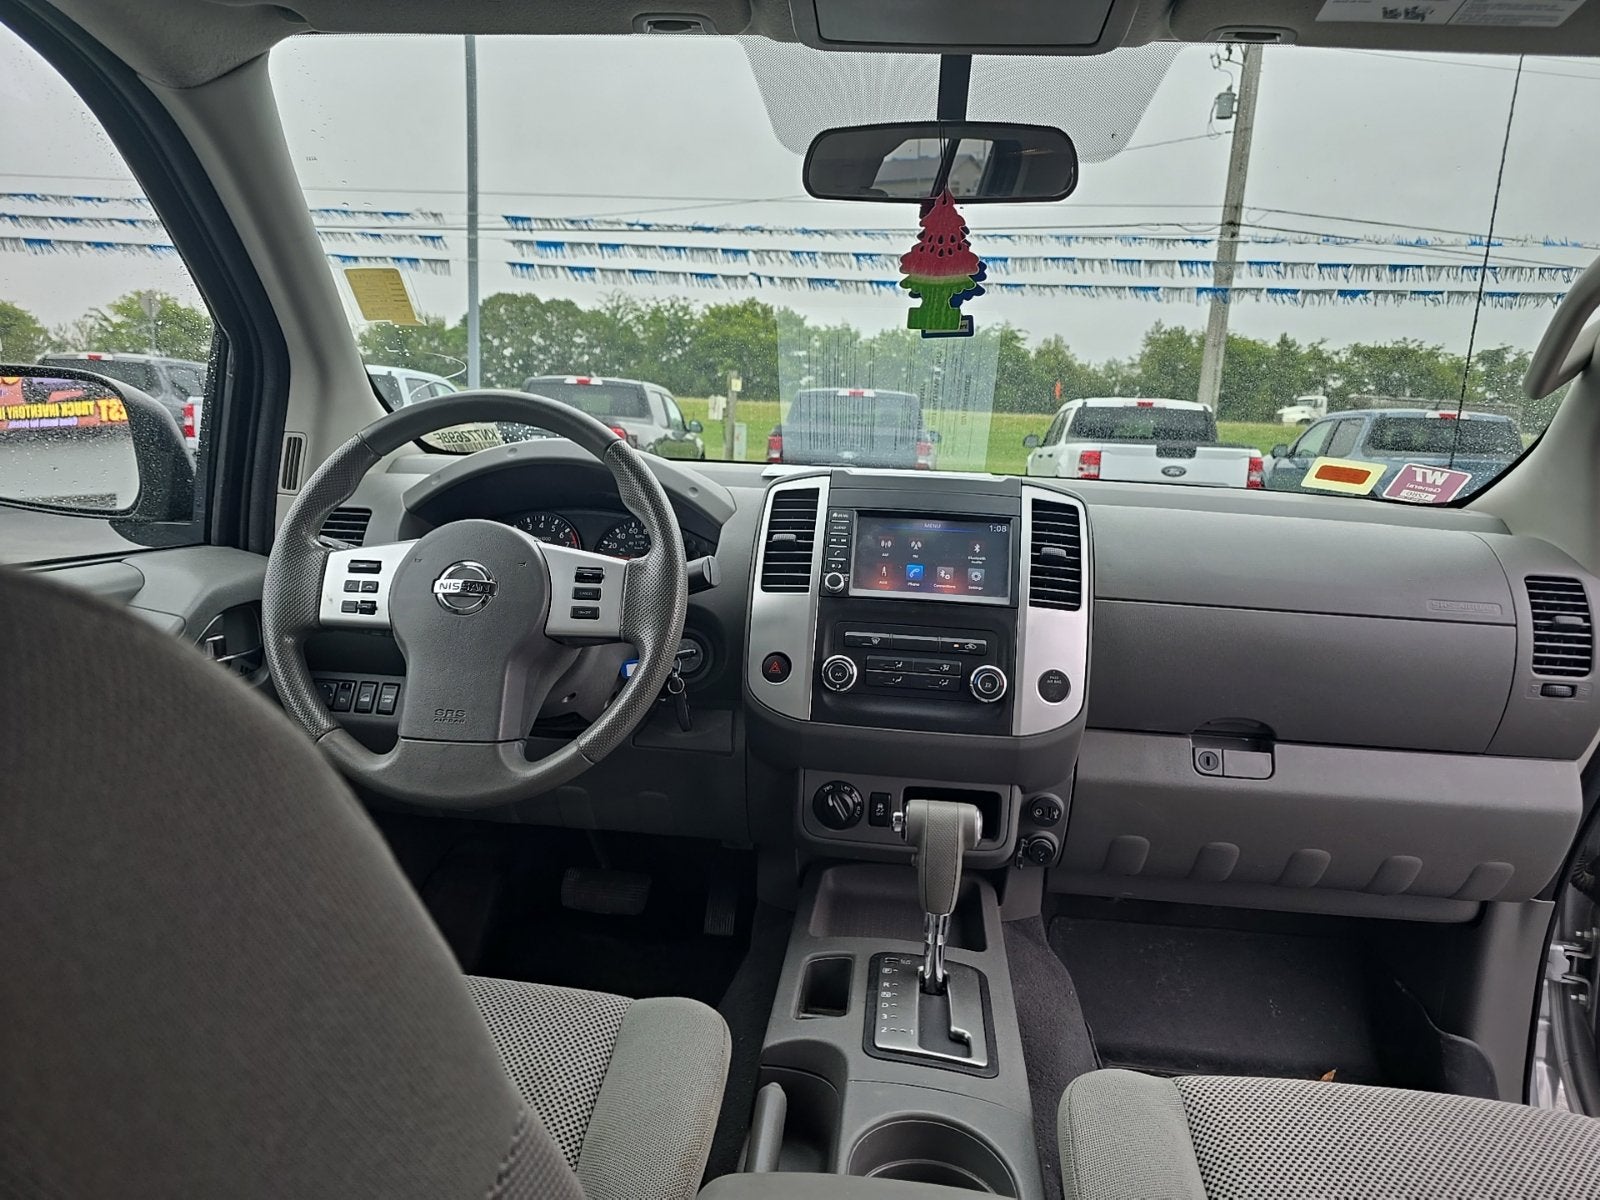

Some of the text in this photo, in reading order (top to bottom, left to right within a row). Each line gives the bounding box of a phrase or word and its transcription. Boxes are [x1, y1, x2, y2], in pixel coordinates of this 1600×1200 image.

[989, 524, 1007, 533] 1:08
[439, 582, 491, 593] NISSAN
[435, 708, 467, 718] SRS
